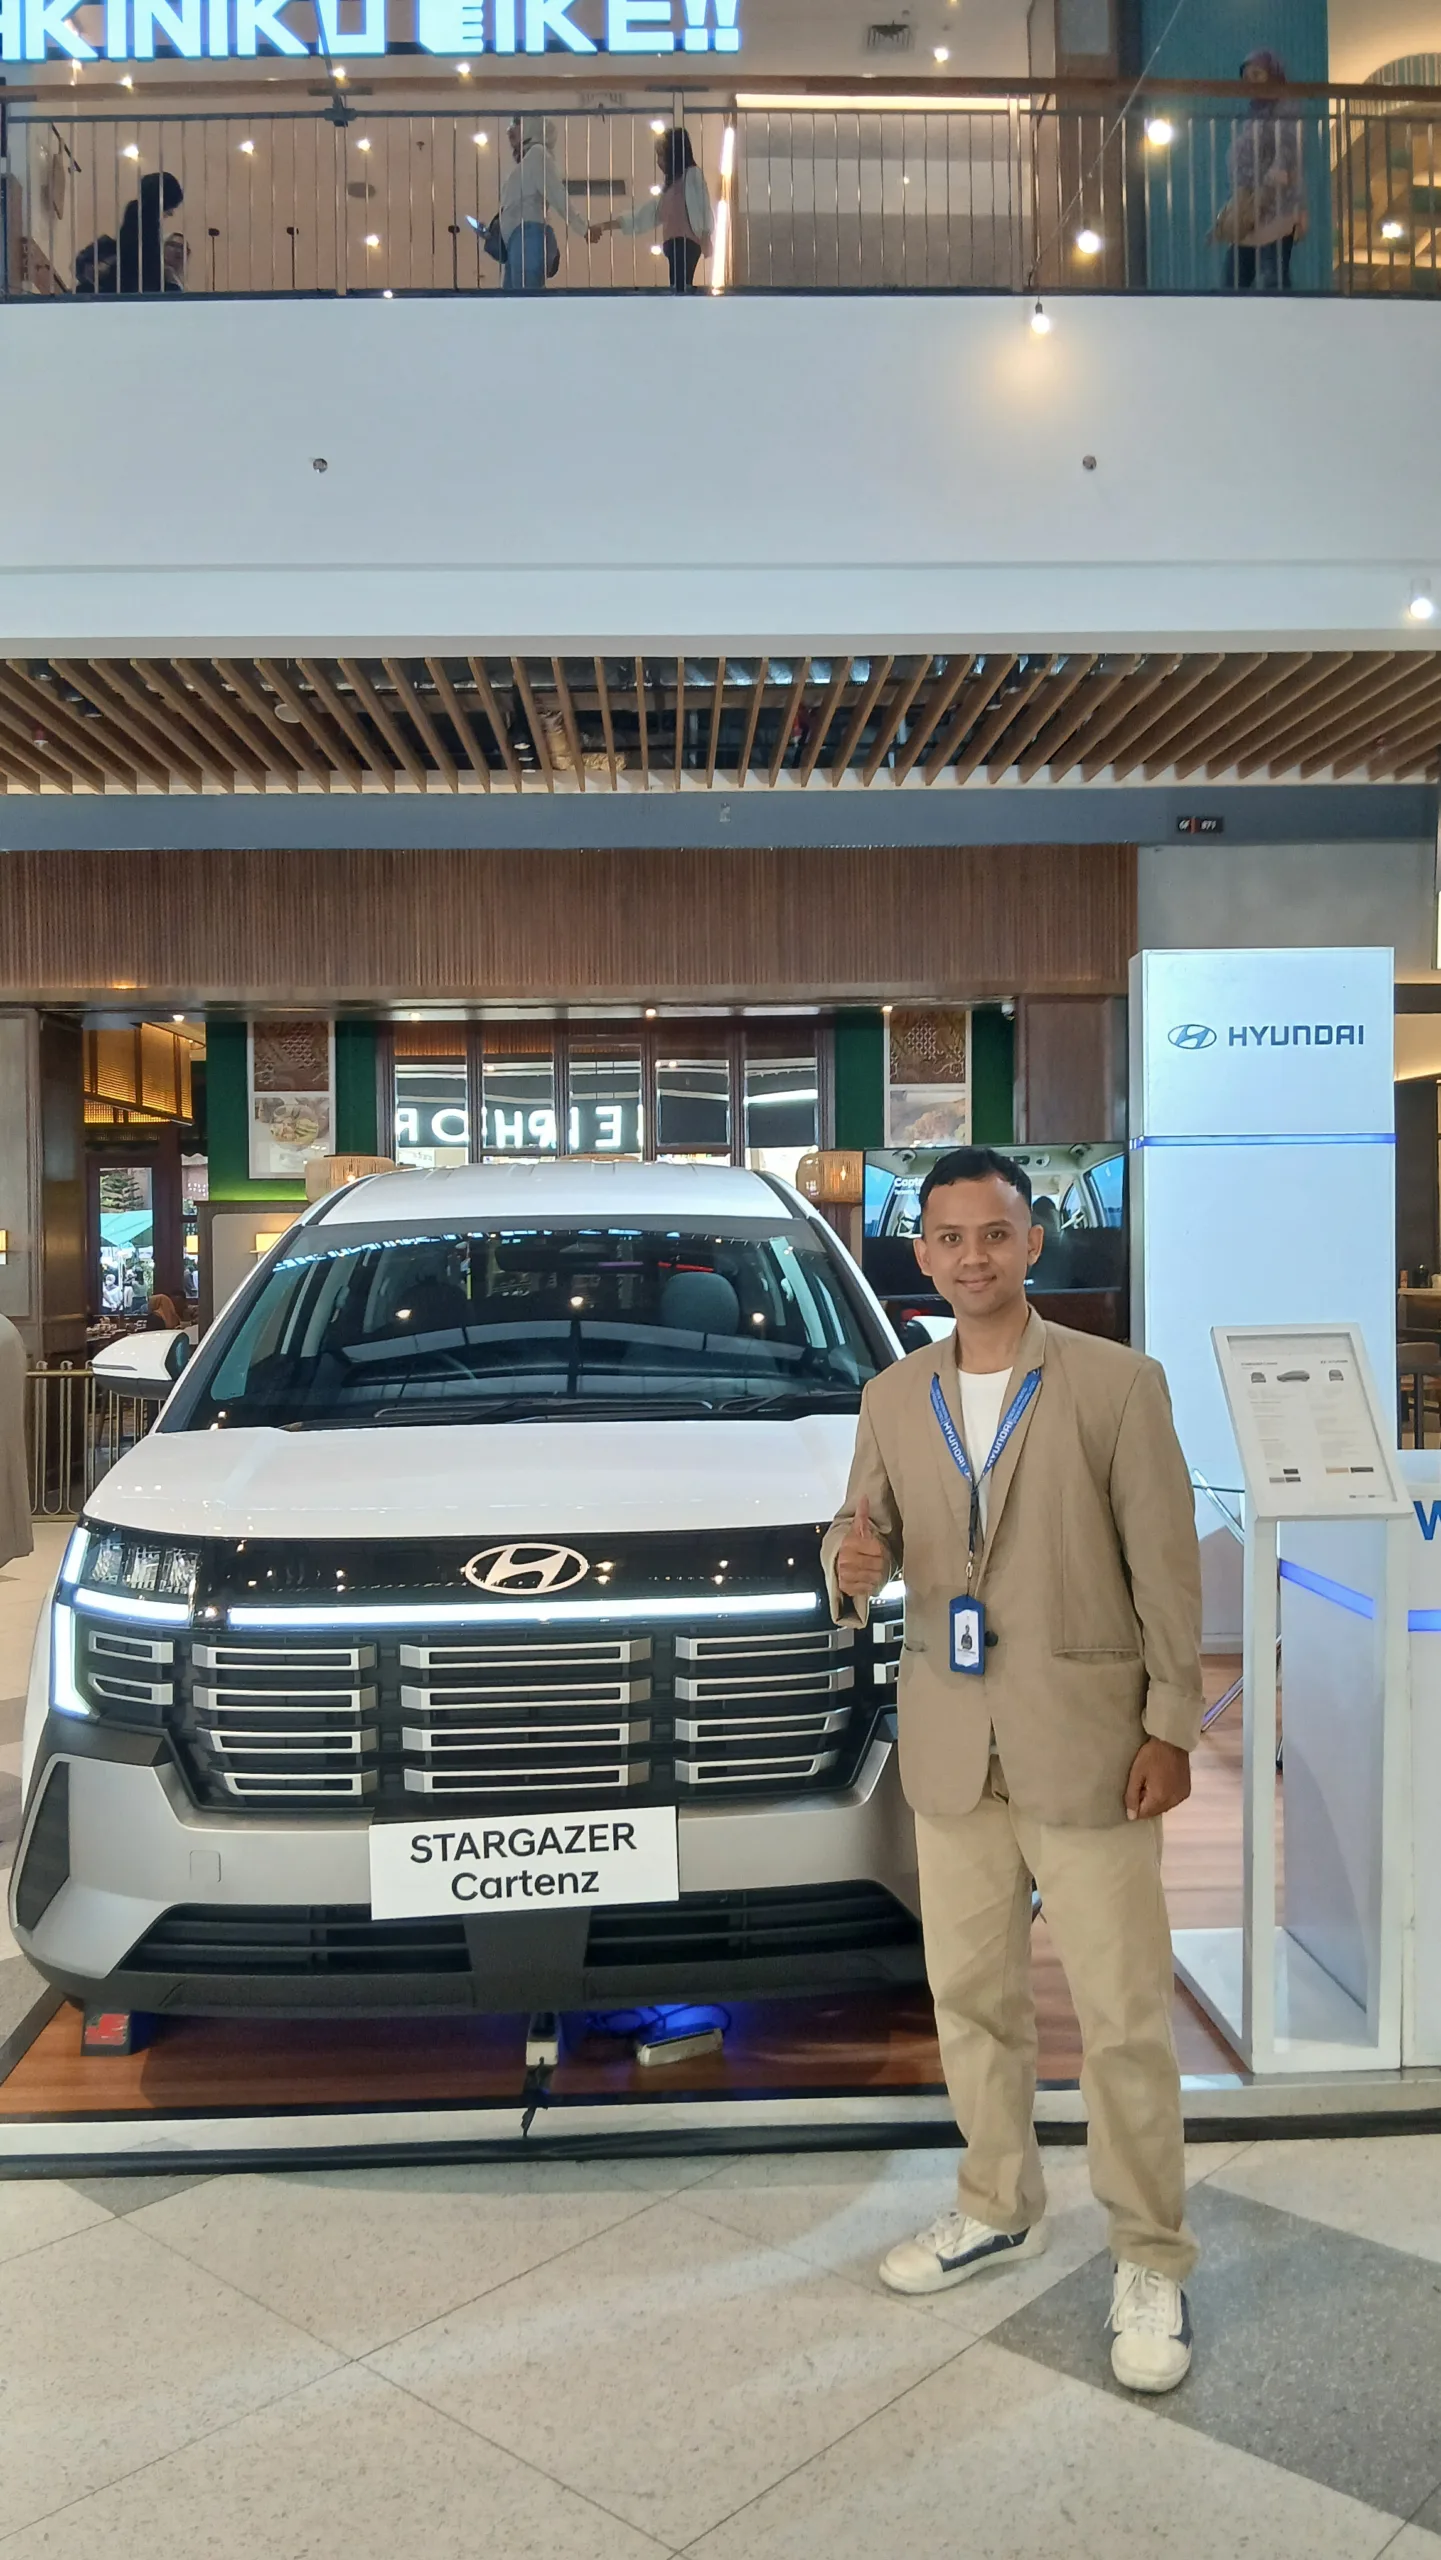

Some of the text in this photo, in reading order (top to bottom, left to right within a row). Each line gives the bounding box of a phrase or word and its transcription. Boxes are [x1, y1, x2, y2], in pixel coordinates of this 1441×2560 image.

[1228, 1025, 1364, 1046] HYUNDAI
[943, 1421, 966, 1468] HYUNDAI
[986, 1421, 1013, 1468] HYUNDAI
[410, 1822, 637, 1864] STARGAZER
[451, 1869, 600, 1901] Cartenz
